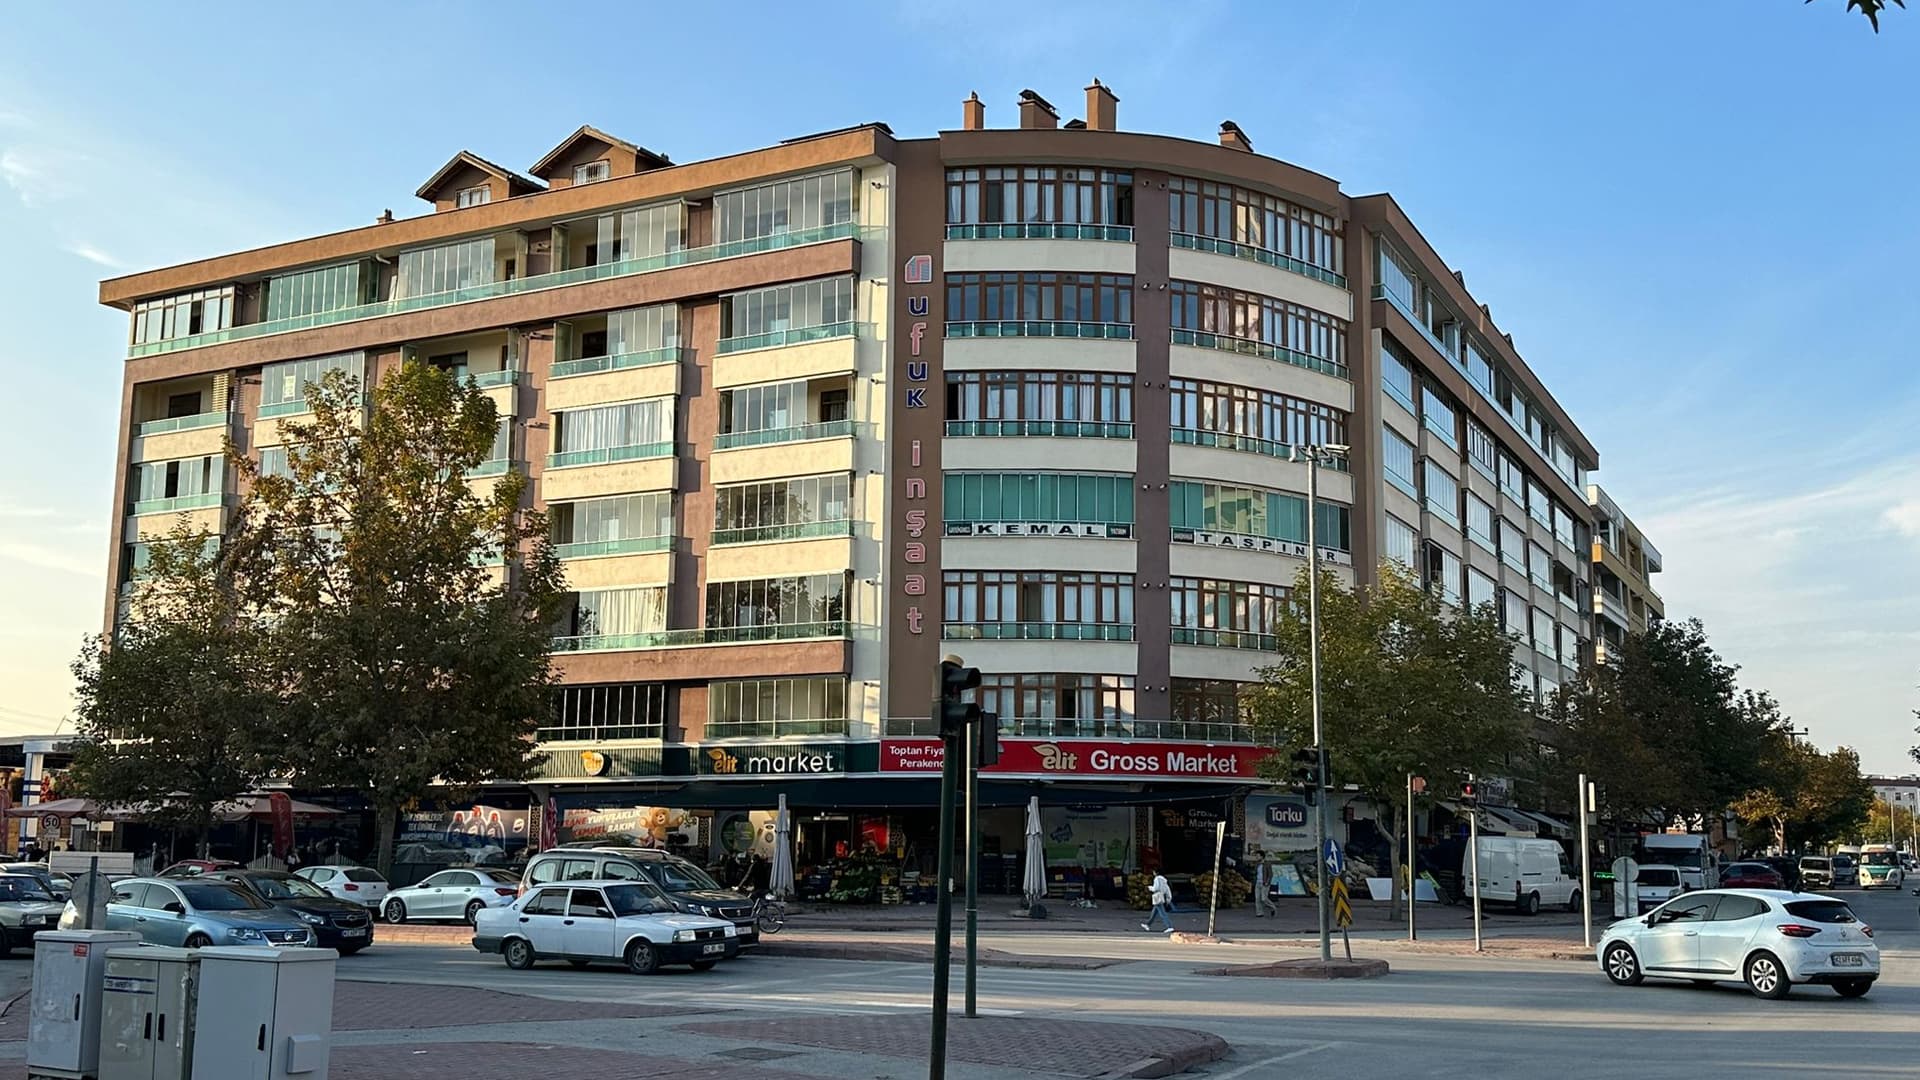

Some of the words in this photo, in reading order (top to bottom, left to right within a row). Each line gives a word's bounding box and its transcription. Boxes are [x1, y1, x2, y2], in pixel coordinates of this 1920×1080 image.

[905, 295, 929, 408] ufuk
[904, 440, 926, 634] inşaat
[977, 524, 1100, 535] KEMAL
[707, 747, 738, 774] elit
[748, 751, 834, 773] market
[889, 745, 923, 757] Toptan
[924, 745, 945, 757] Fiya
[1033, 743, 1078, 770] elit
[1090, 749, 1160, 772] Gross
[1167, 751, 1238, 774] Market
[45, 816, 58, 828] 50
[1269, 807, 1303, 822] Torku
